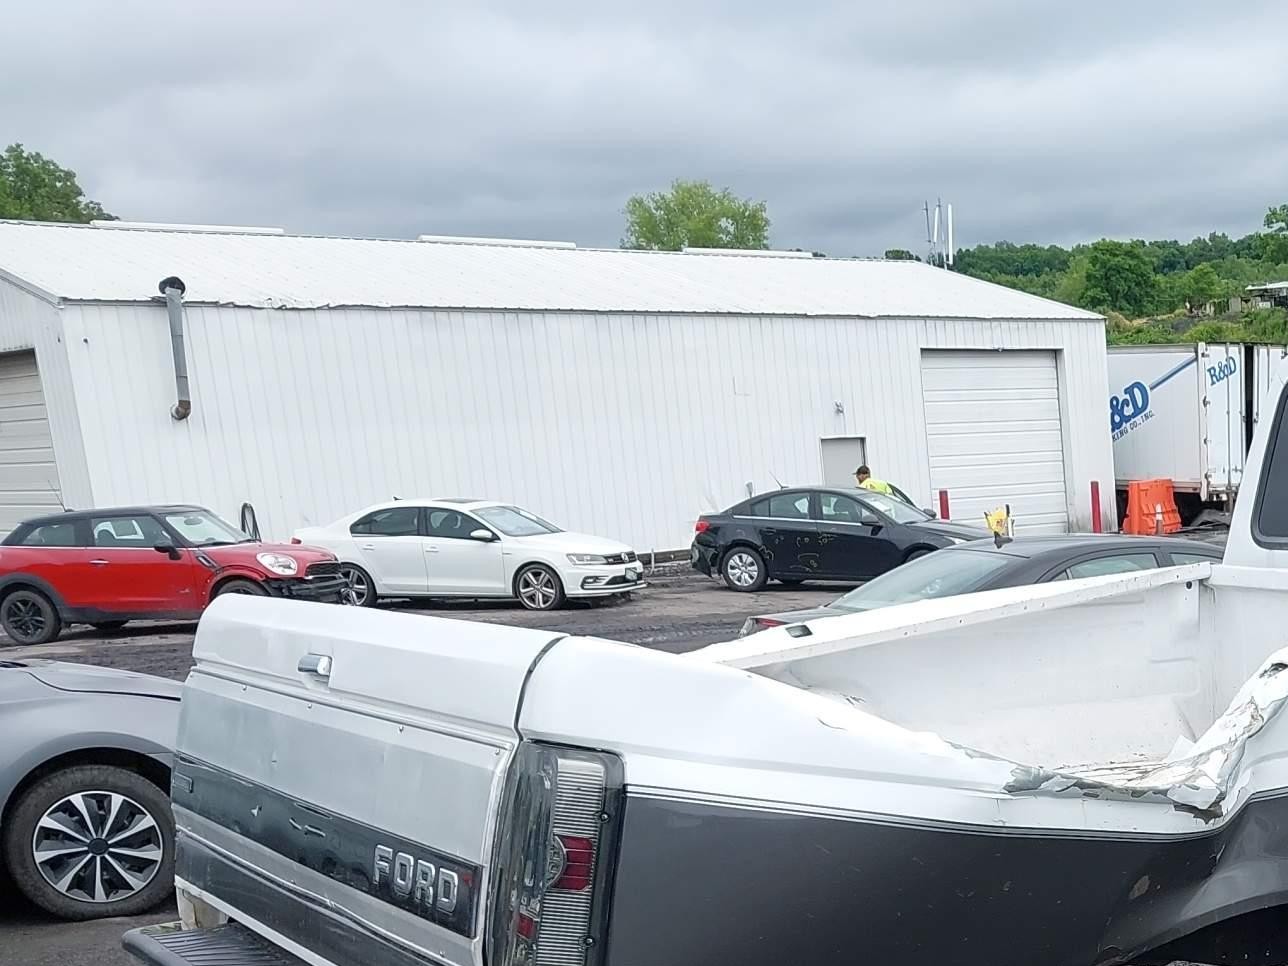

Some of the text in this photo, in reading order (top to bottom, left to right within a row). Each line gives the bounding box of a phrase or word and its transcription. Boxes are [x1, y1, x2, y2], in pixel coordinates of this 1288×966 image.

[1207, 356, 1237, 386] R&D
[1110, 381, 1149, 433] &D
[1112, 427, 1129, 442] KING
[373, 844, 459, 915] FORD
